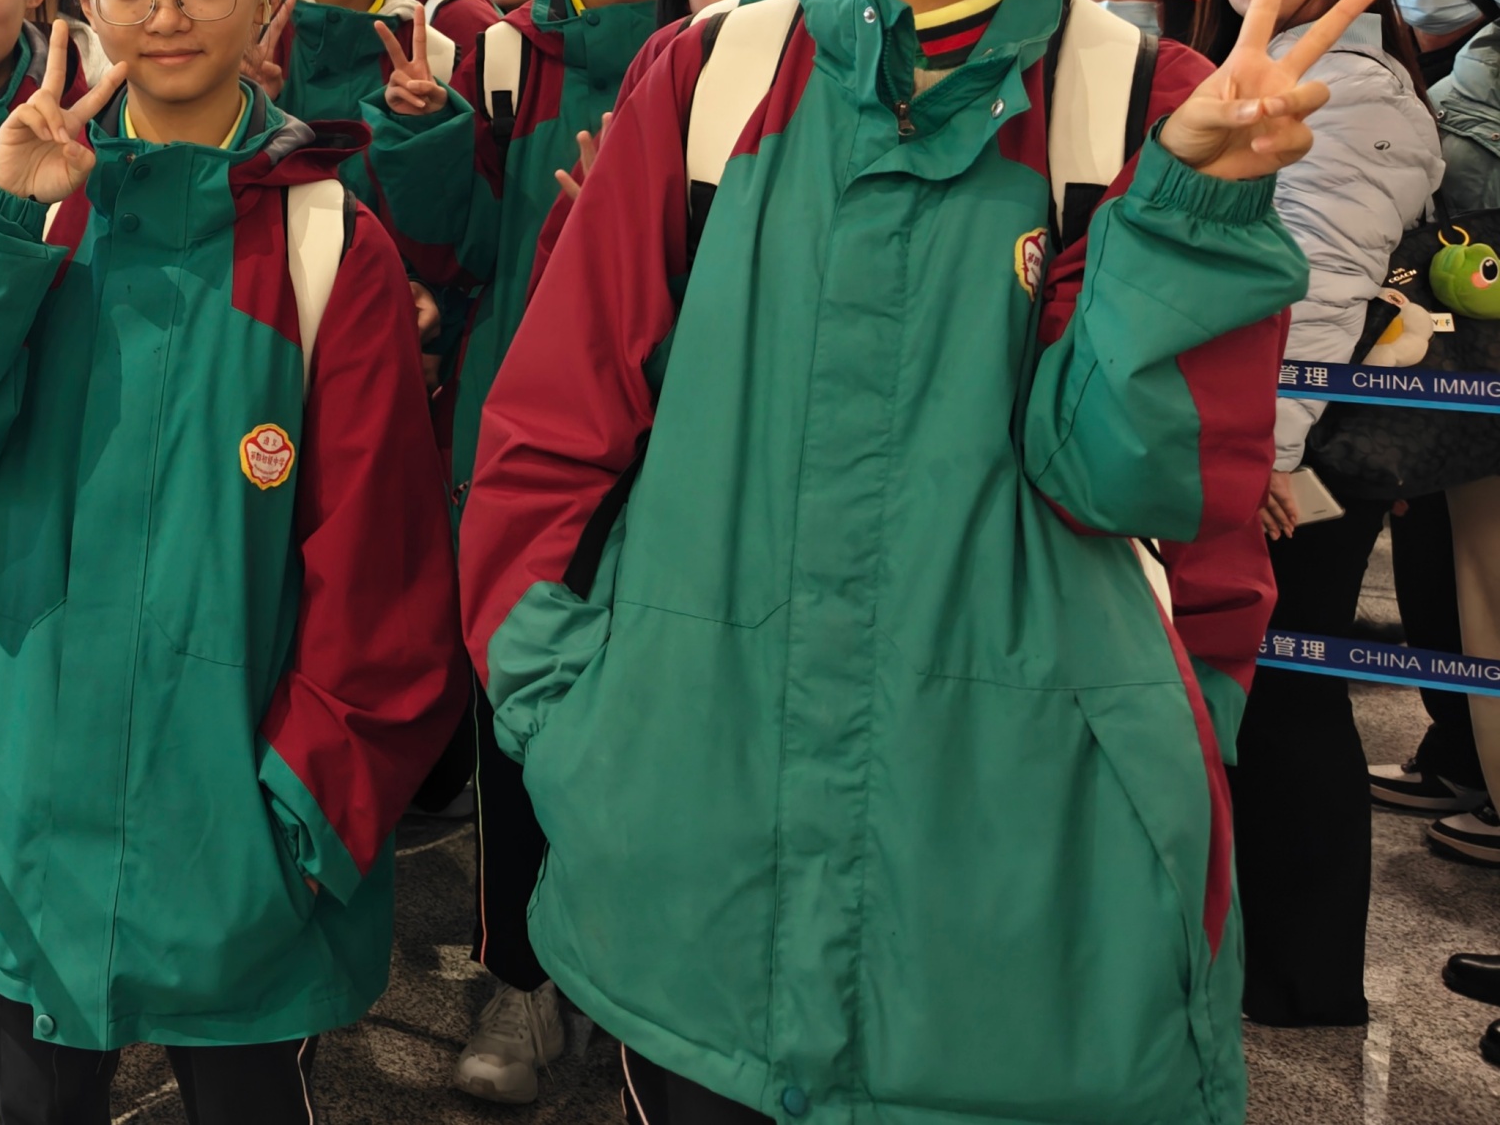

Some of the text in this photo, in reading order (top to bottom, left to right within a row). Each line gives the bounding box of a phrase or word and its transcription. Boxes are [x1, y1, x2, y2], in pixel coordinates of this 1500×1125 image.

[1278, 364, 1329, 387] 管理
[1352, 372, 1424, 392] CHINA
[1349, 648, 1421, 671] CHINA
